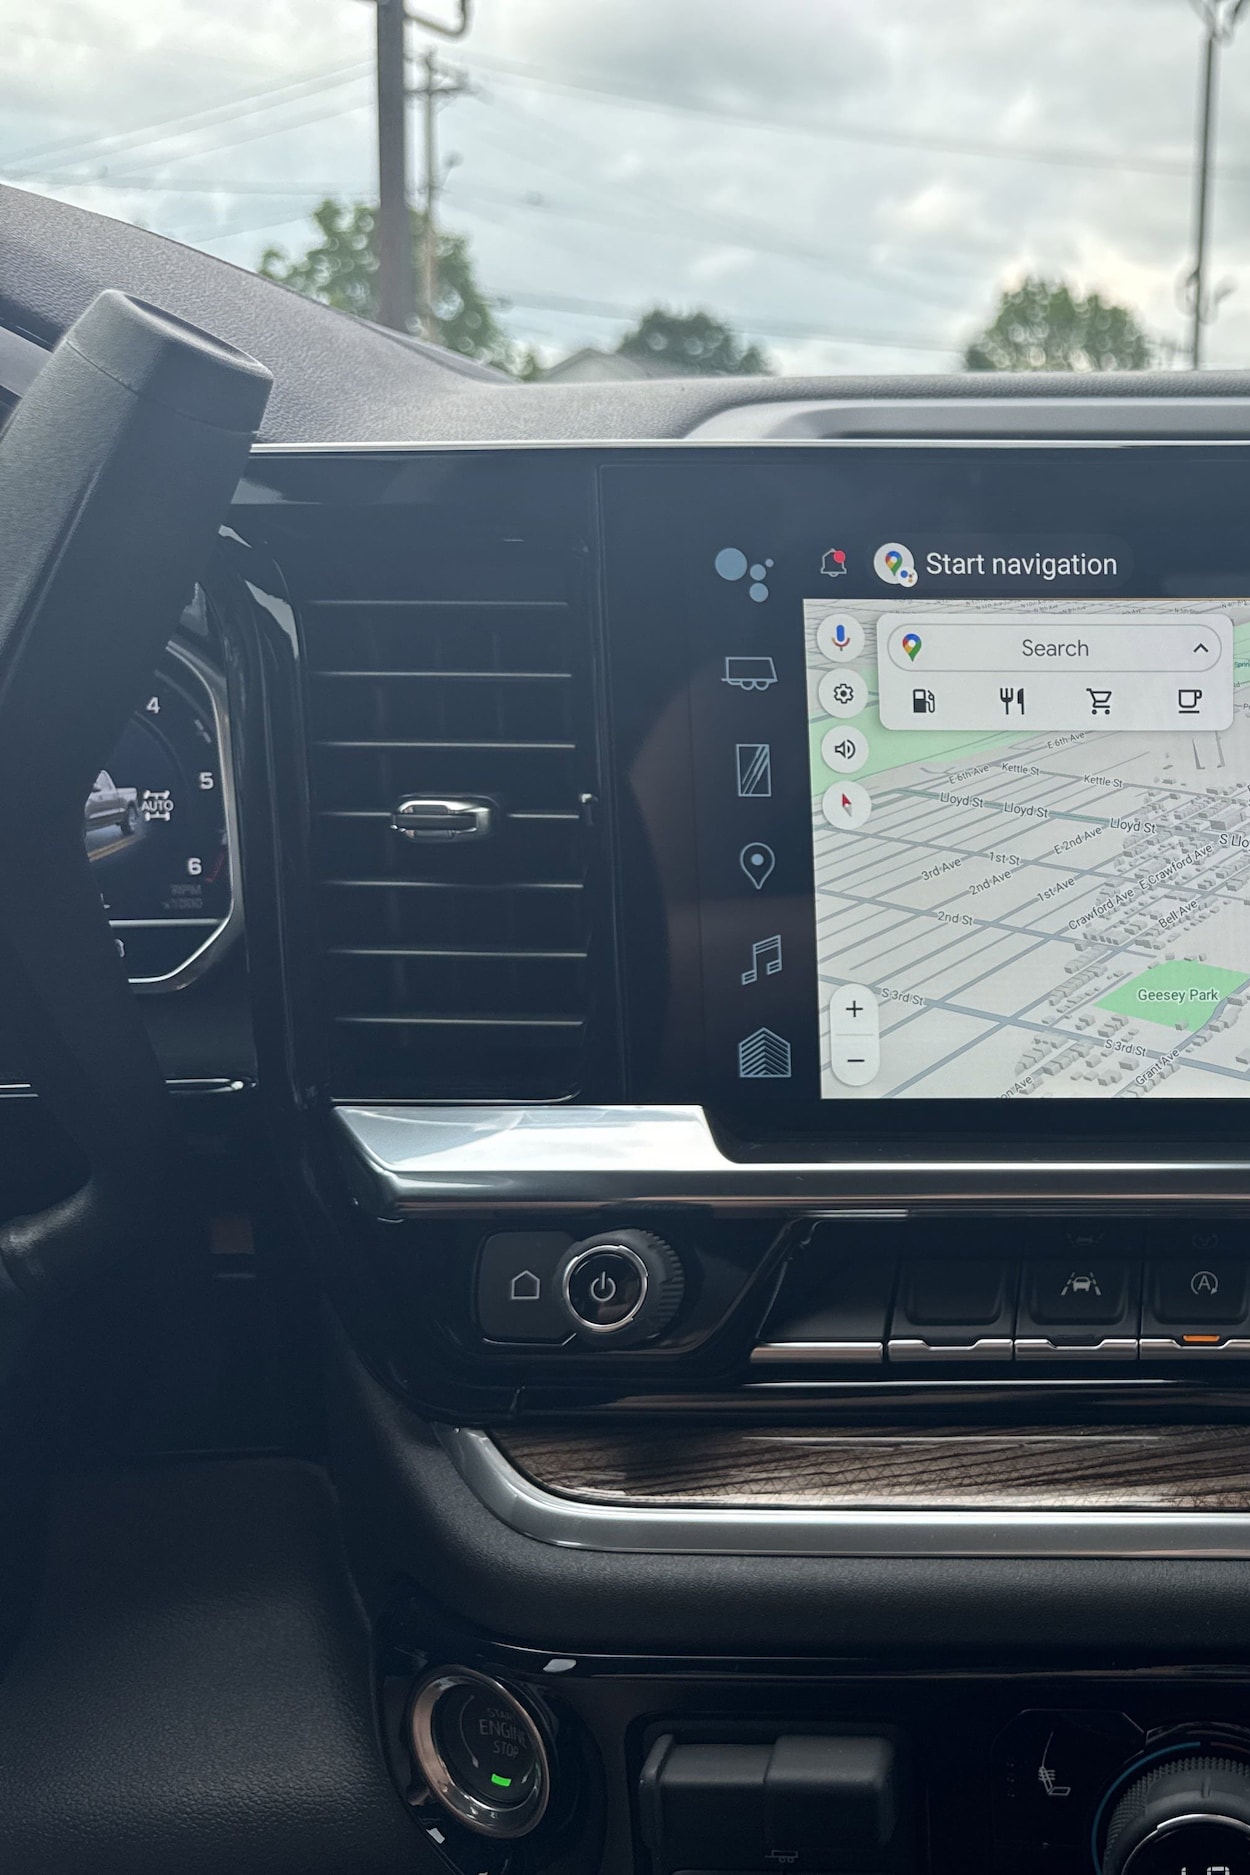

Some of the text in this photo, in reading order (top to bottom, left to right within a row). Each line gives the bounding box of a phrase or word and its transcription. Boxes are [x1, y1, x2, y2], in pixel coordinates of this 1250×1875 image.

[926, 553, 1117, 580] Start navigation
[1022, 639, 1089, 657] Search
[146, 697, 160, 713] 4
[1002, 763, 1040, 776] Kettle St
[200, 772, 214, 789] 5
[1084, 774, 1123, 788] Kettle St
[141, 799, 174, 812] AUTO
[940, 792, 984, 809] Lloyd St
[1004, 802, 1049, 819] Lloyd St
[1110, 818, 1156, 834] Lloyd St
[1219, 834, 1228, 845] S
[188, 858, 202, 875] 6
[989, 852, 1021, 867] 1st St
[1138, 844, 1214, 890] E Crawford Ave
[921, 858, 962, 881] 3rd Ave
[968, 870, 1013, 896] 2nd Ave
[1037, 877, 1076, 902] 1st Ave
[1068, 888, 1134, 931] Crawford Ave
[1158, 899, 1199, 929] Bell Ave
[938, 911, 974, 926] 2nd St
[881, 987, 924, 1006] S 3rd St
[1137, 988, 1219, 1004] Geesey Park
[1104, 1039, 1147, 1057] S 3rd St
[1135, 1049, 1180, 1086] Grant Ave
[479, 1718, 528, 1748] ENGINE
[493, 1739, 519, 1759] STOP
